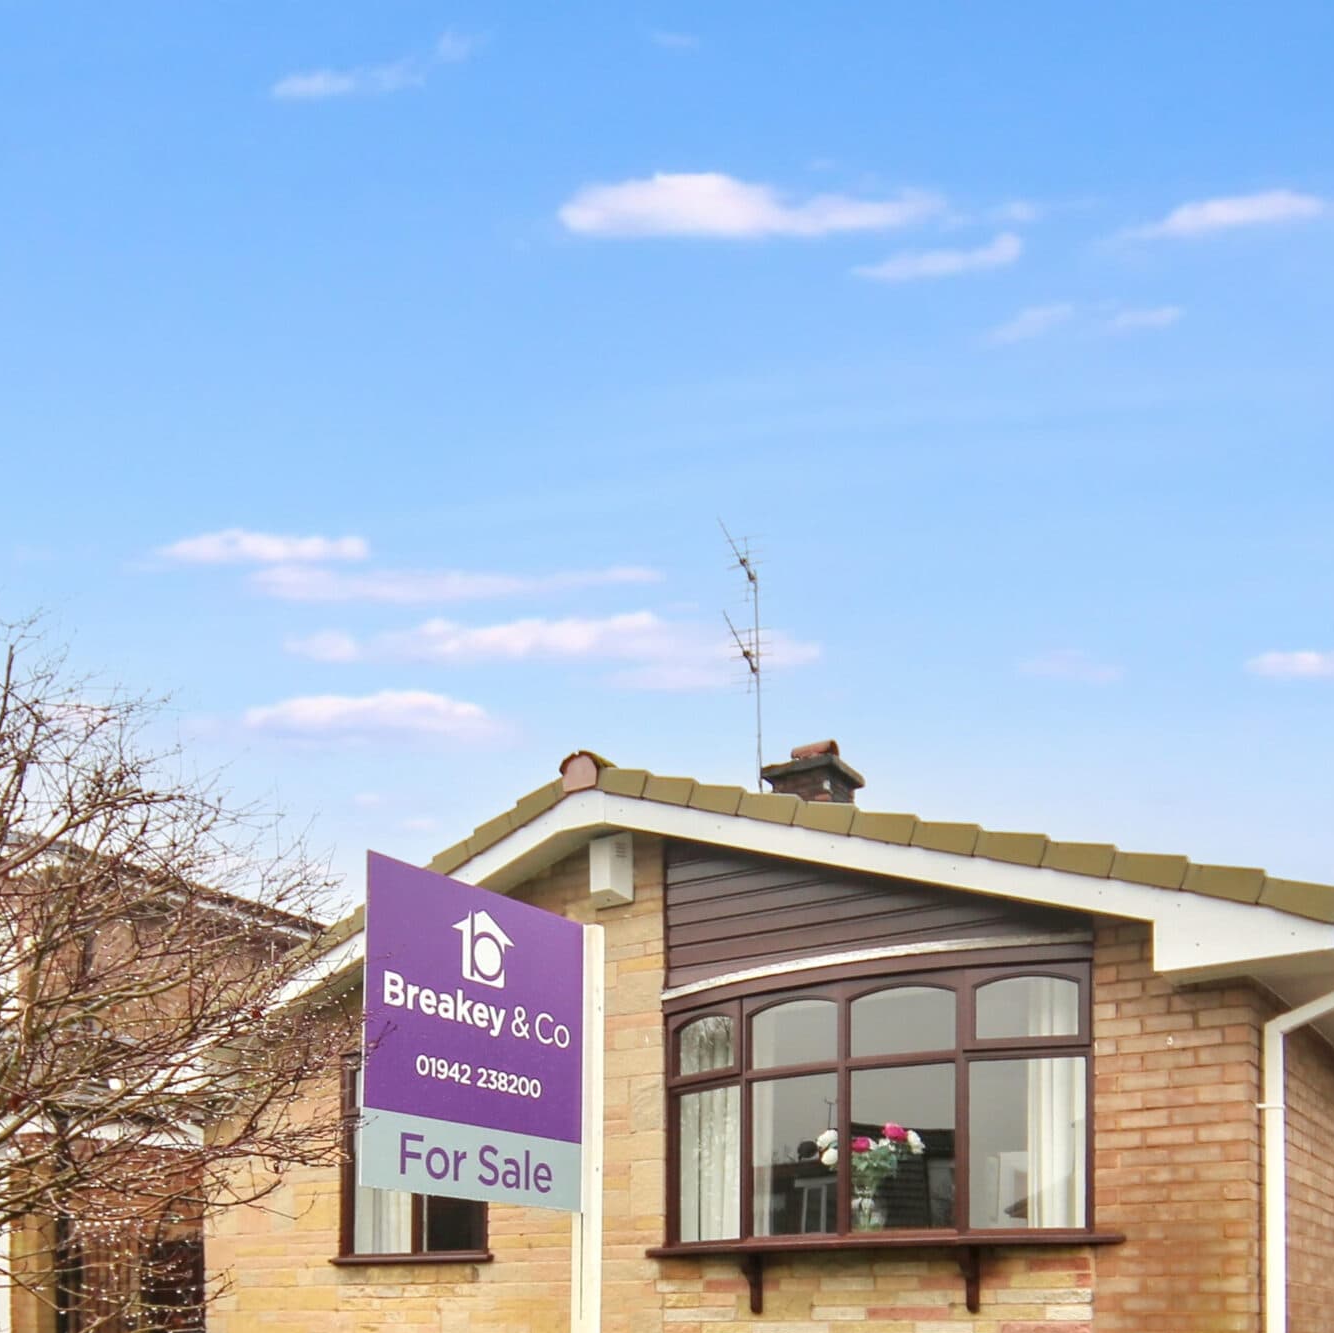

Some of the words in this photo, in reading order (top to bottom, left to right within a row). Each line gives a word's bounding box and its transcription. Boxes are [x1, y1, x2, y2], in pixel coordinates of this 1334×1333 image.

[383, 970, 507, 1038] Breakey
[535, 1013, 571, 1049] Co
[415, 1054, 472, 1086] 01942
[477, 1067, 542, 1099] 238200
[399, 1132, 468, 1182] For
[478, 1145, 553, 1194] Sale
